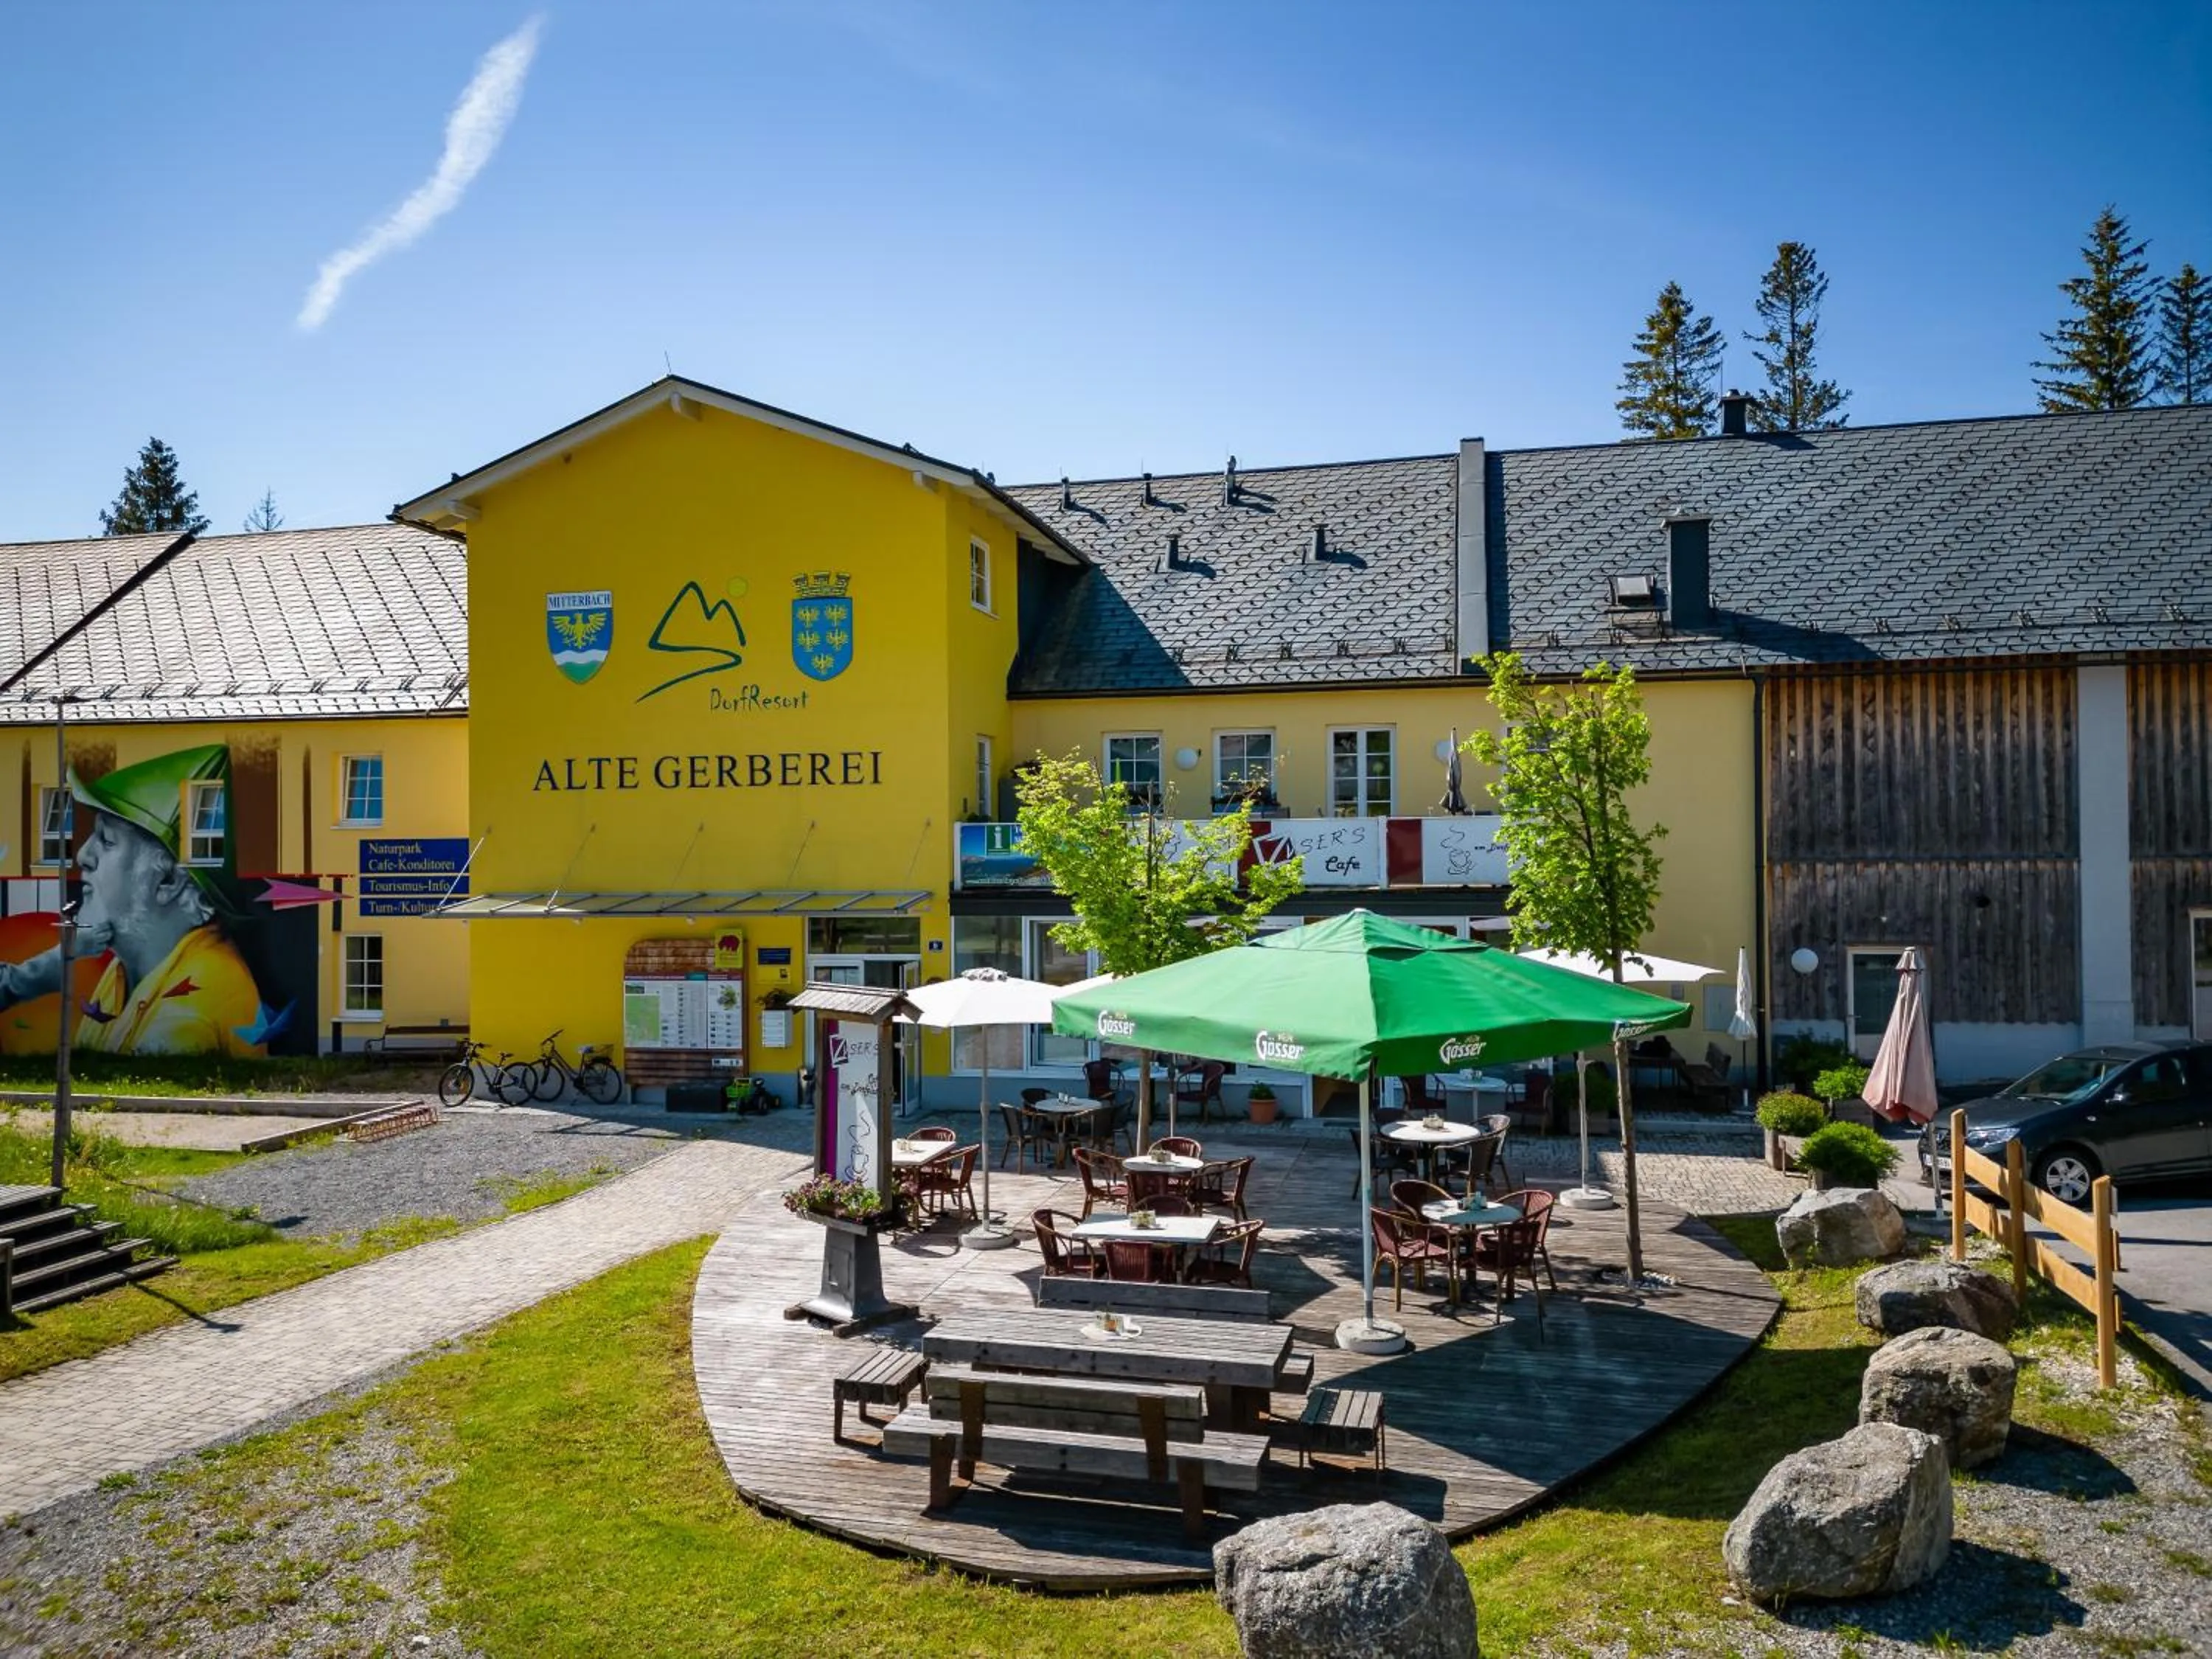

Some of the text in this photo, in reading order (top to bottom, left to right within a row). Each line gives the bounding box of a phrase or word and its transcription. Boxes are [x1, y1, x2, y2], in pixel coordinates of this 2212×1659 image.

[548, 593, 611, 608] MITTERBACH
[709, 684, 808, 713] DorfResort
[532, 751, 883, 790] ALTE GERBEREI
[368, 841, 422, 857] Naturpark
[368, 858, 455, 872] Cafe-Konditorei
[1325, 855, 1362, 877] Cafe
[368, 879, 451, 892] Tourismus-Info
[1098, 1010, 1136, 1036] Gösser
[1256, 1030, 1304, 1061] Gösser
[1440, 1037, 1487, 1065] Gösser
